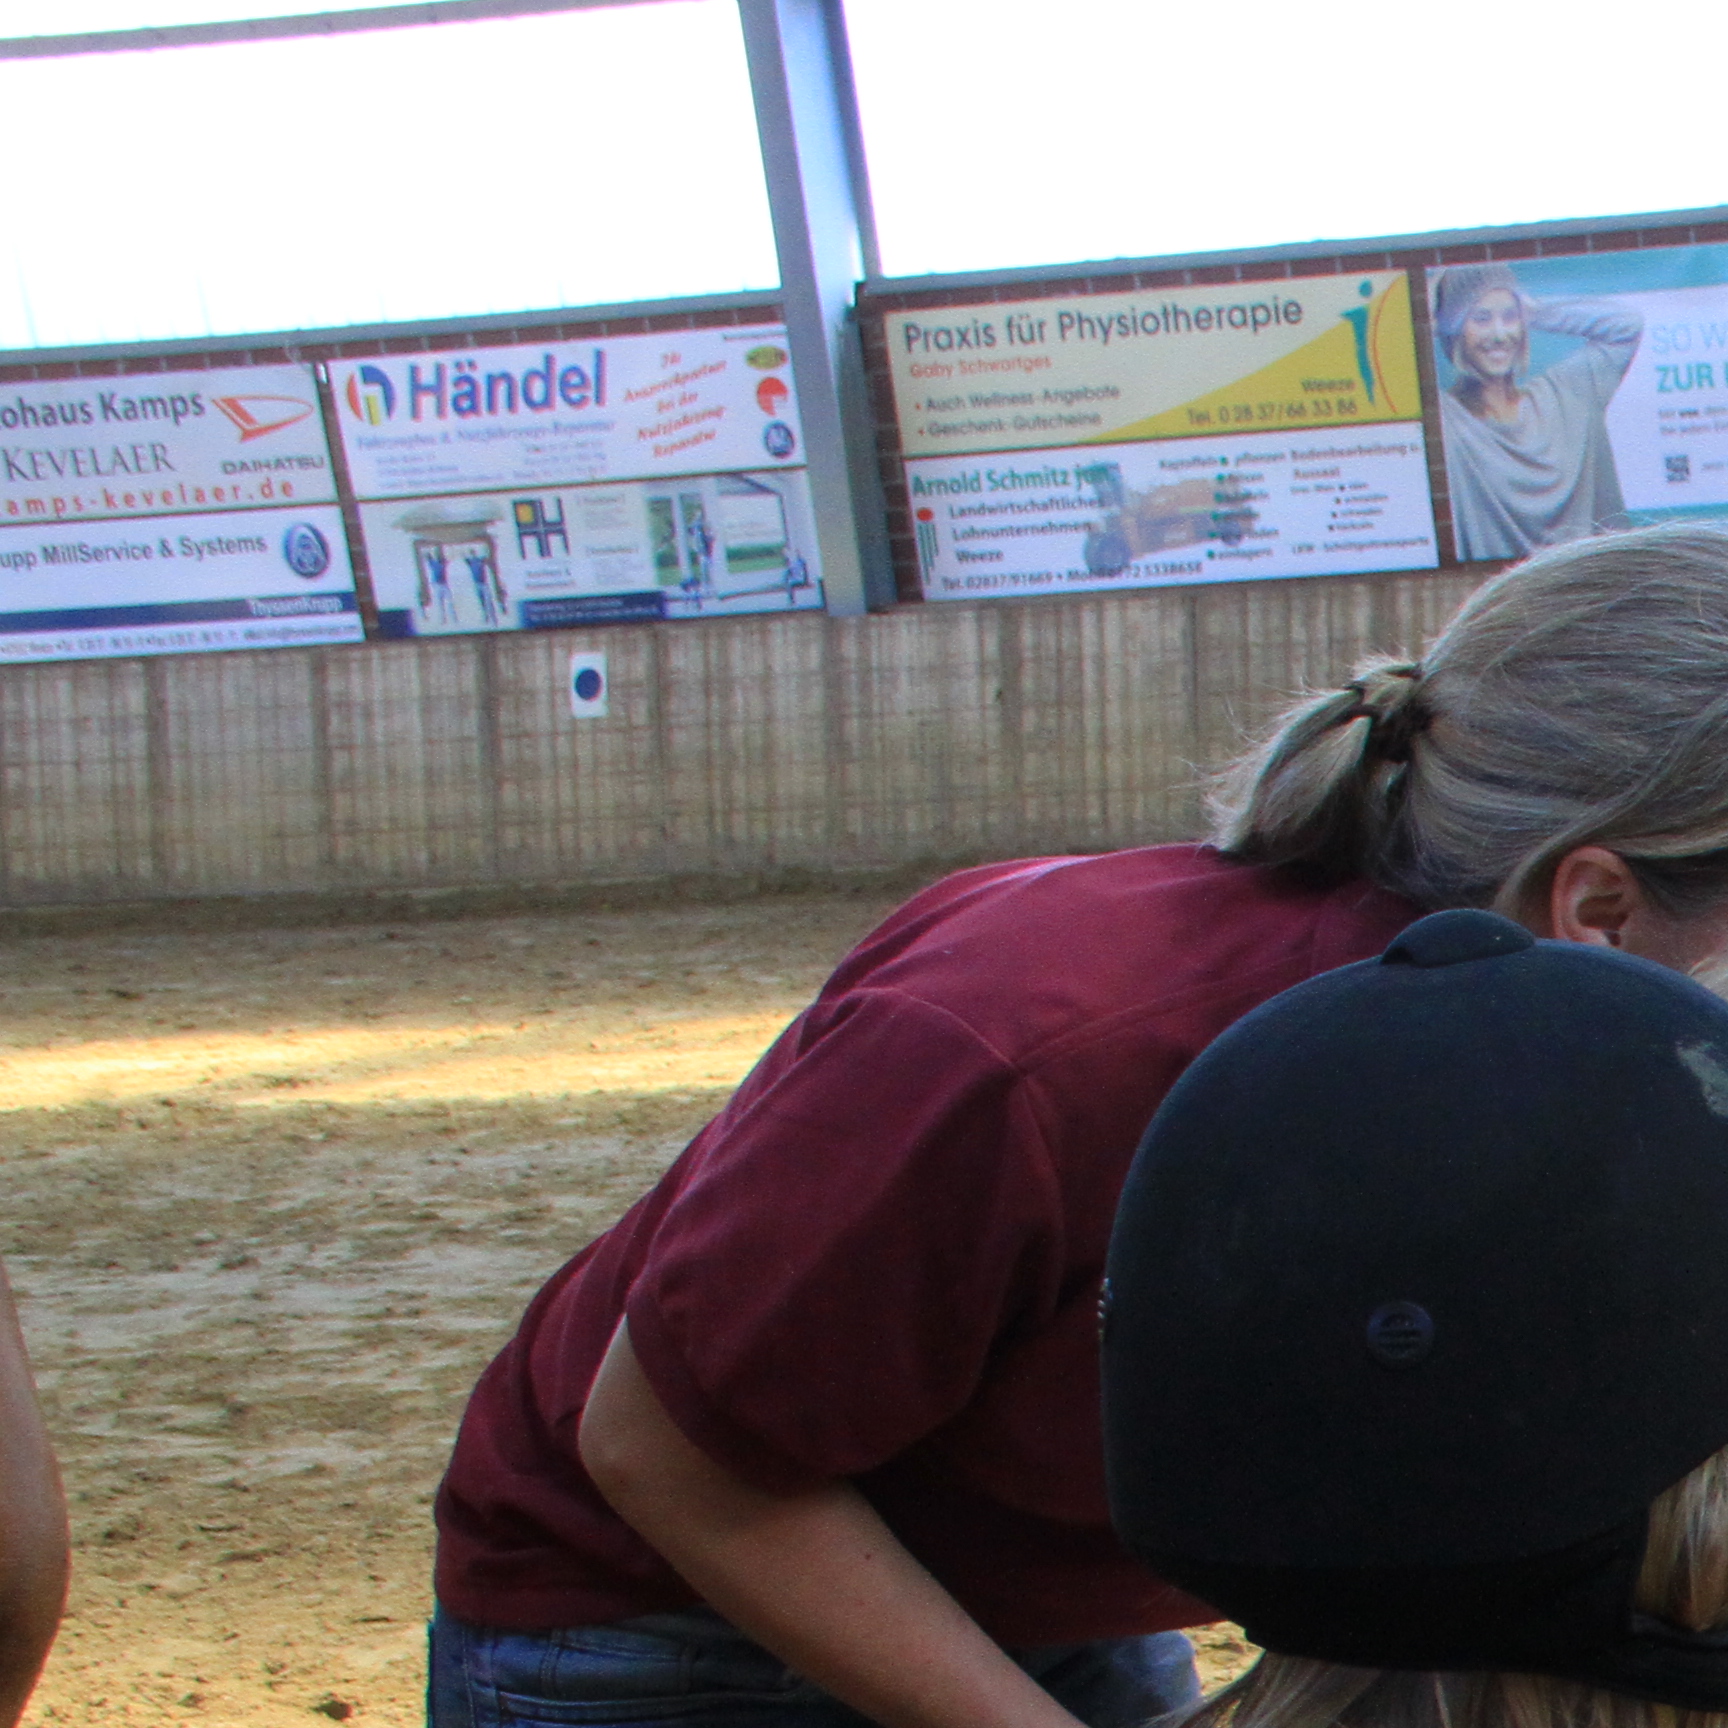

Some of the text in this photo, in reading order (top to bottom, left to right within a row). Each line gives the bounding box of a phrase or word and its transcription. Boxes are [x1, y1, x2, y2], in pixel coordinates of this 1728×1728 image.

[904, 295, 1304, 353] Praxis für Physiotherapie
[1651, 322, 1692, 353] SO
[409, 347, 608, 423] Händel
[1655, 362, 1715, 392] ZUR
[0, 391, 206, 429] ohaus Kamps
[5, 442, 177, 483] KEVELAER
[222, 455, 327, 476] DAIHATSU
[912, 468, 982, 498] Arnold
[986, 464, 1069, 491] Schmitz
[1, 477, 294, 519] amps-kevelaer.de
[0, 533, 268, 572] upp MillService & Systems
